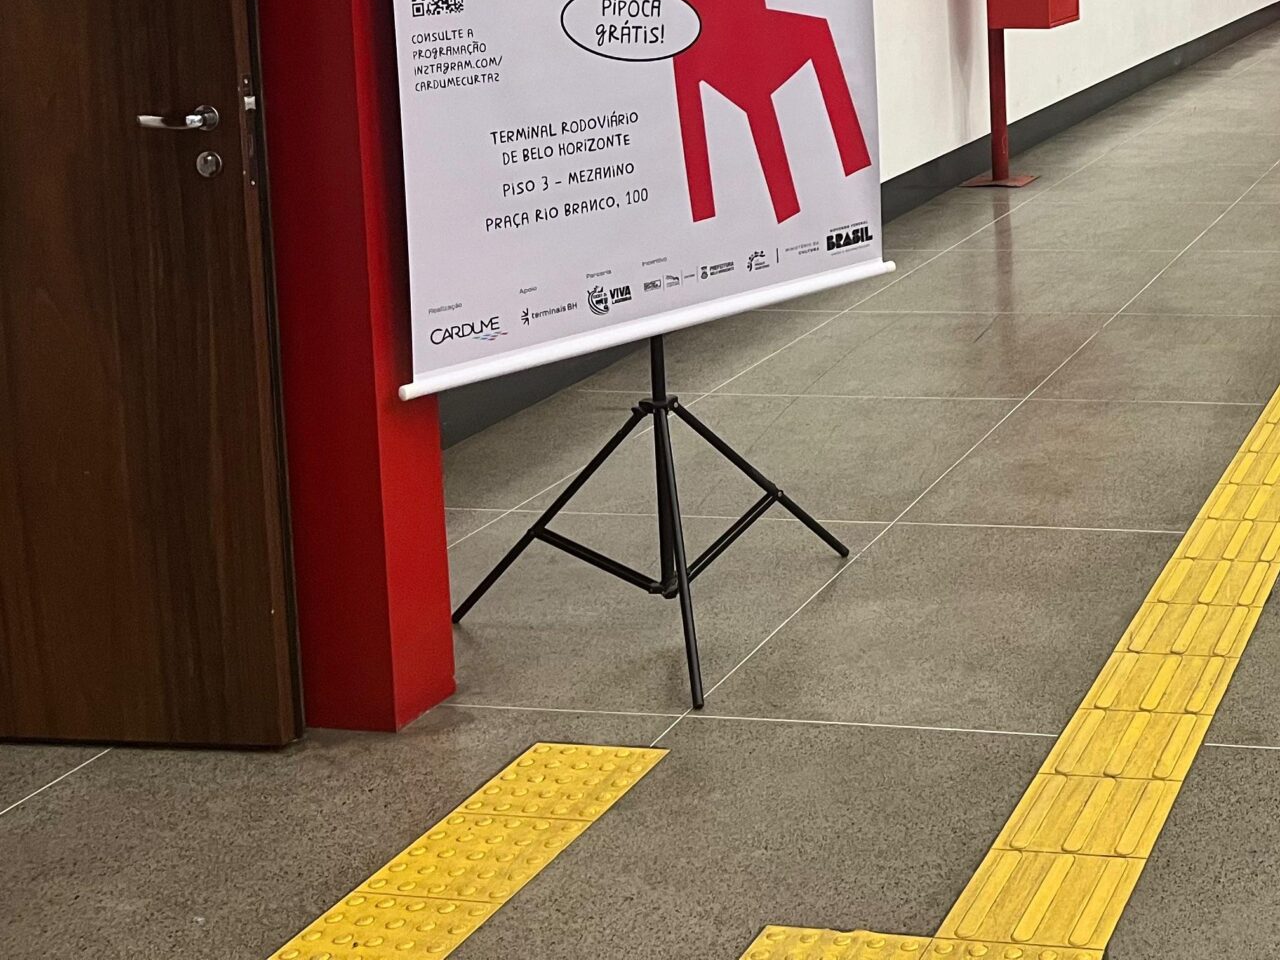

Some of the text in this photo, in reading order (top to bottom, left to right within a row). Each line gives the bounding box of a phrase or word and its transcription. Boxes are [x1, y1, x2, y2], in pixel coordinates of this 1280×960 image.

[411, 28, 474, 44] CONSULTE A
[502, 150, 518, 166] DE
[522, 145, 554, 162] BELO
[541, 176, 549, 192] 3
[485, 212, 530, 232] PRAÇA
[564, 196, 620, 217] BRANCO,
[625, 187, 649, 206] 100
[826, 226, 873, 252] BRASIL
[519, 286, 538, 295] Apoio
[609, 285, 632, 300] VIVA
[531, 302, 578, 320] terminais BH
[430, 315, 500, 345] CARDUME
